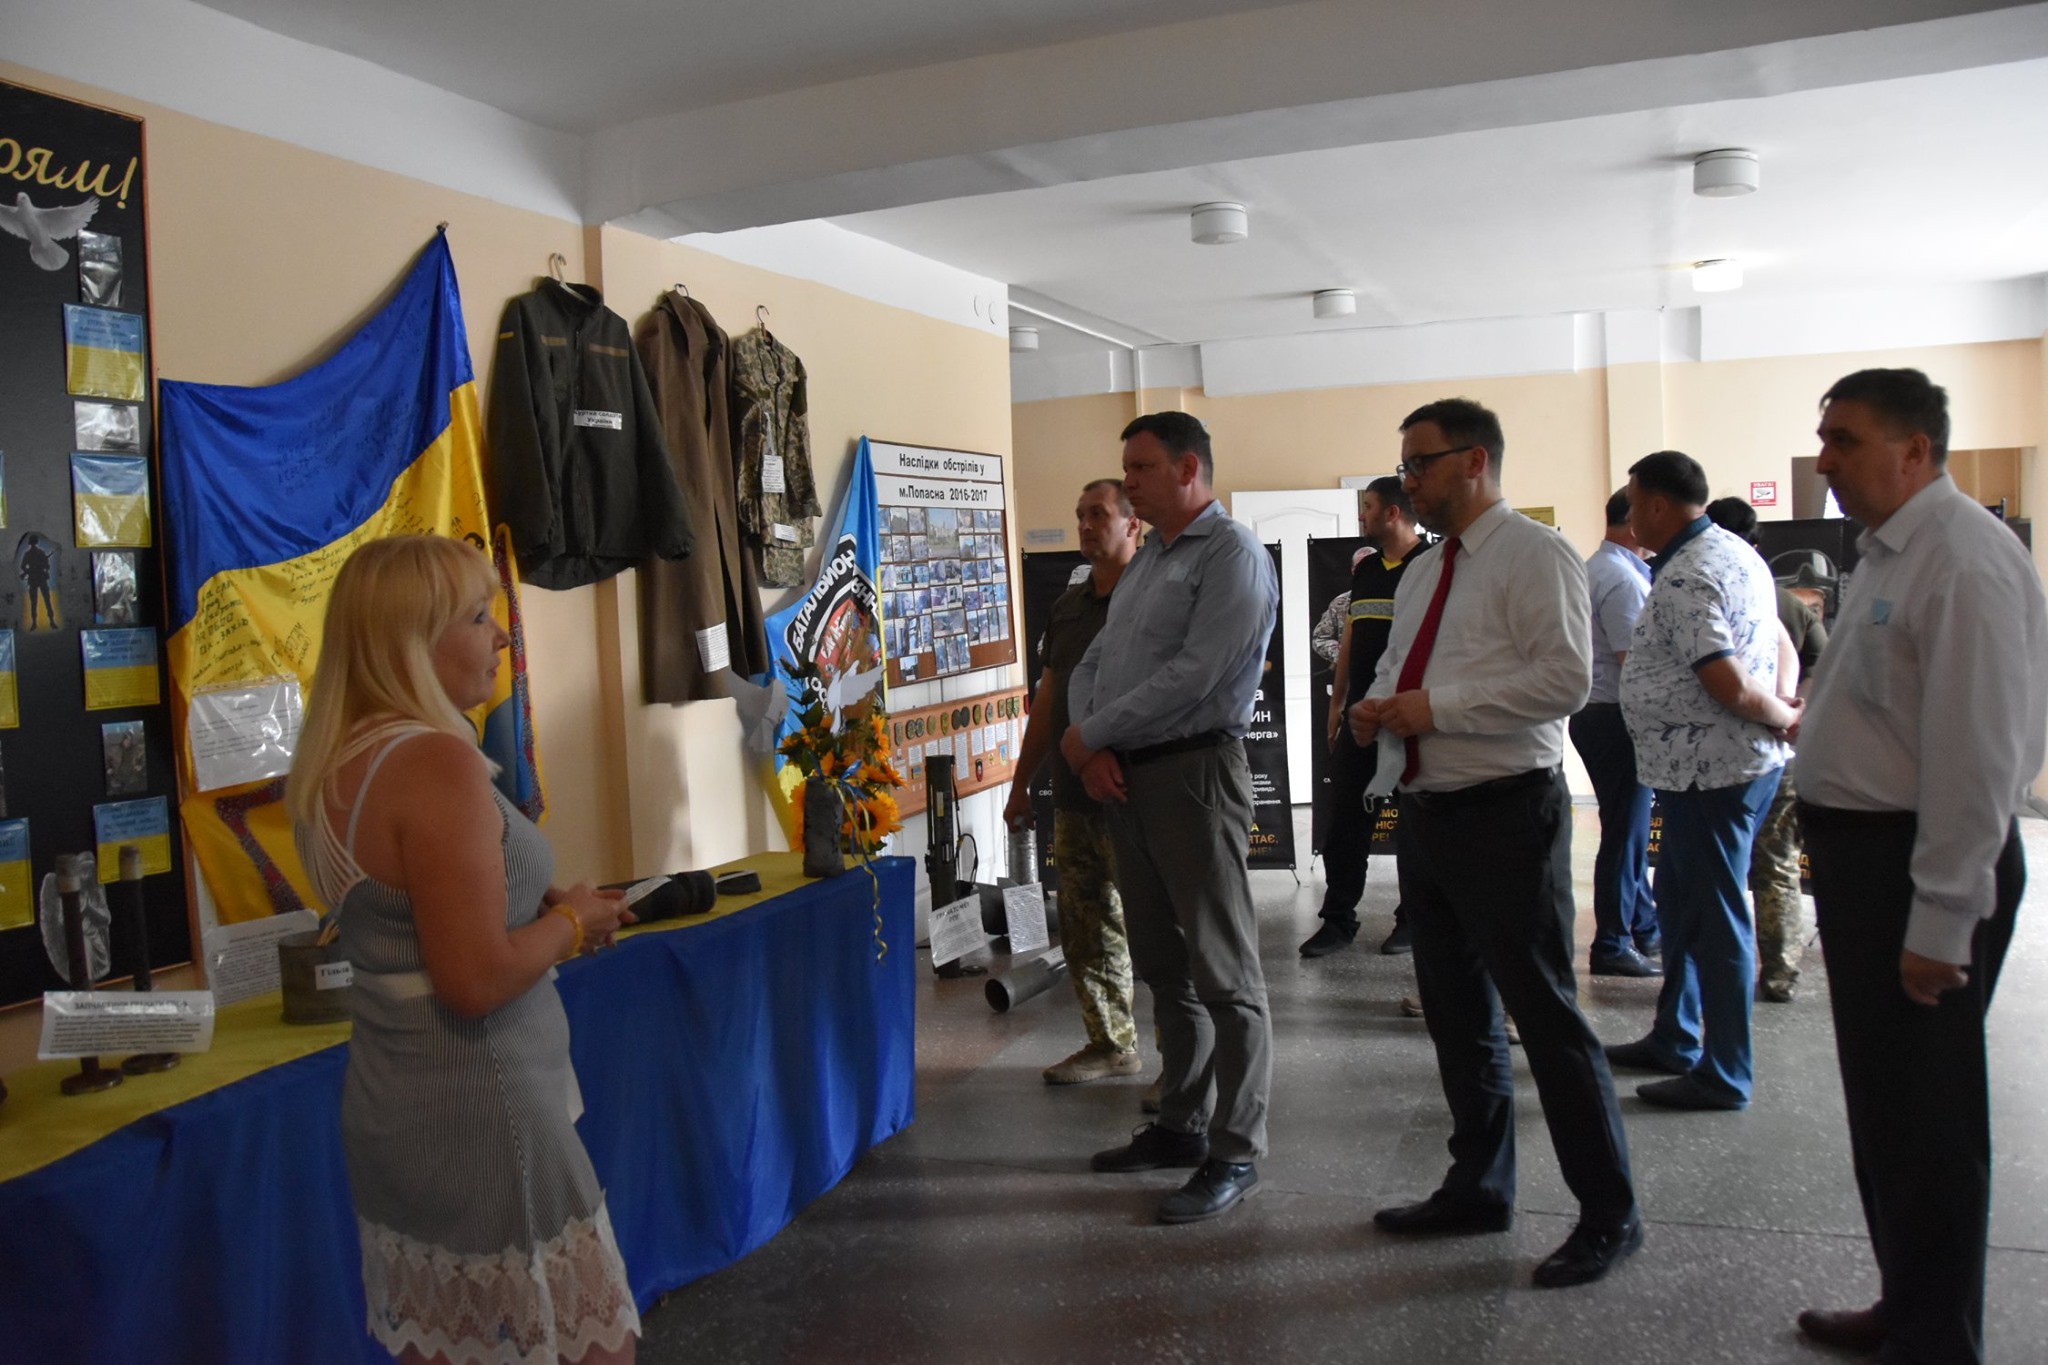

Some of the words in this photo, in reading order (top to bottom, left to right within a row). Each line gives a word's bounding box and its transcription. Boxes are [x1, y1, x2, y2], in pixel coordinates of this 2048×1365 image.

[900, 453, 939, 471] Наслідки
[943, 458, 979, 474] обстрілів
[980, 464, 985, 476] у
[899, 485, 945, 500] м.Попасна
[949, 488, 988, 501] 2016-2017
[1250, 710, 1271, 722] ИН
